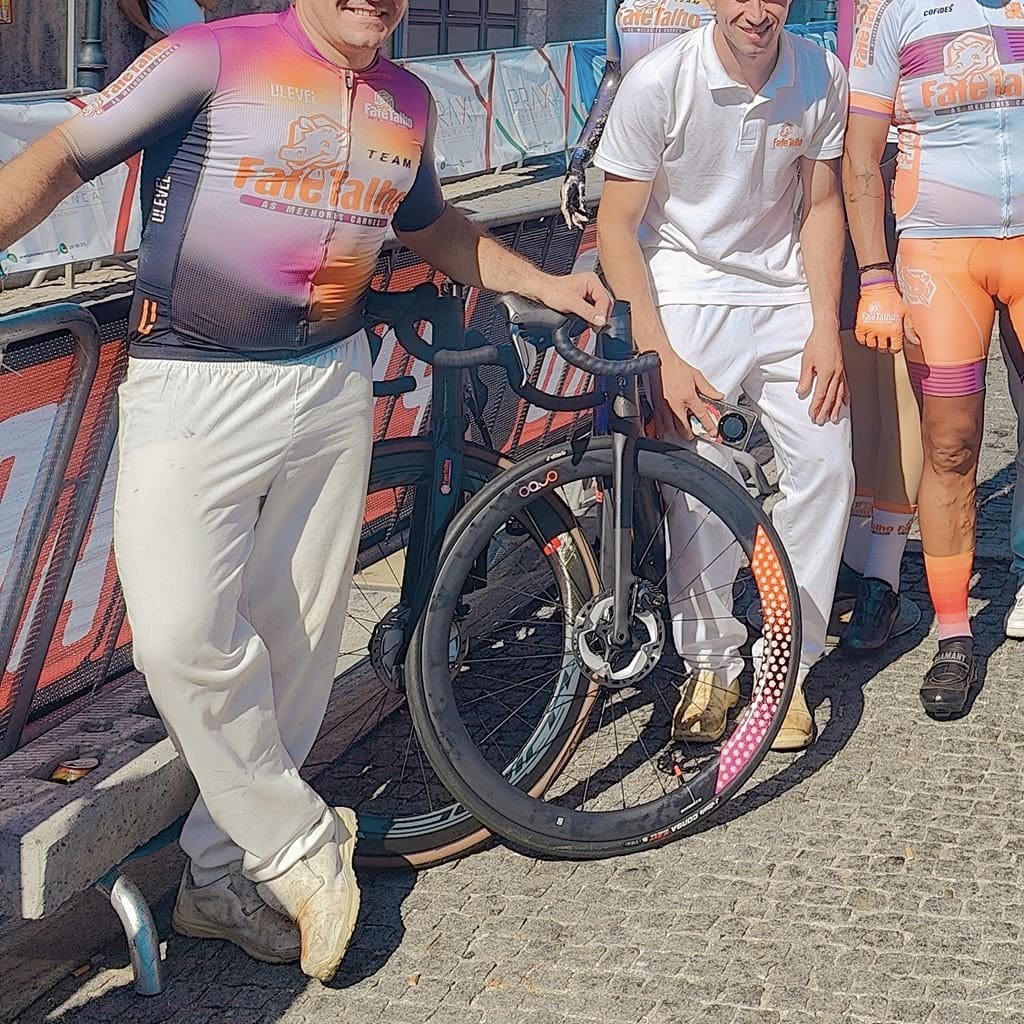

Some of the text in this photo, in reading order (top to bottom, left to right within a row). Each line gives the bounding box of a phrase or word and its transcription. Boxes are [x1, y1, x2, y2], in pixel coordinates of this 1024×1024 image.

[368, 149, 412, 169] TEAM
[152, 176, 173, 224] ULEVEL
[261, 200, 277, 211] AS
[286, 205, 344, 223] MELHORES
